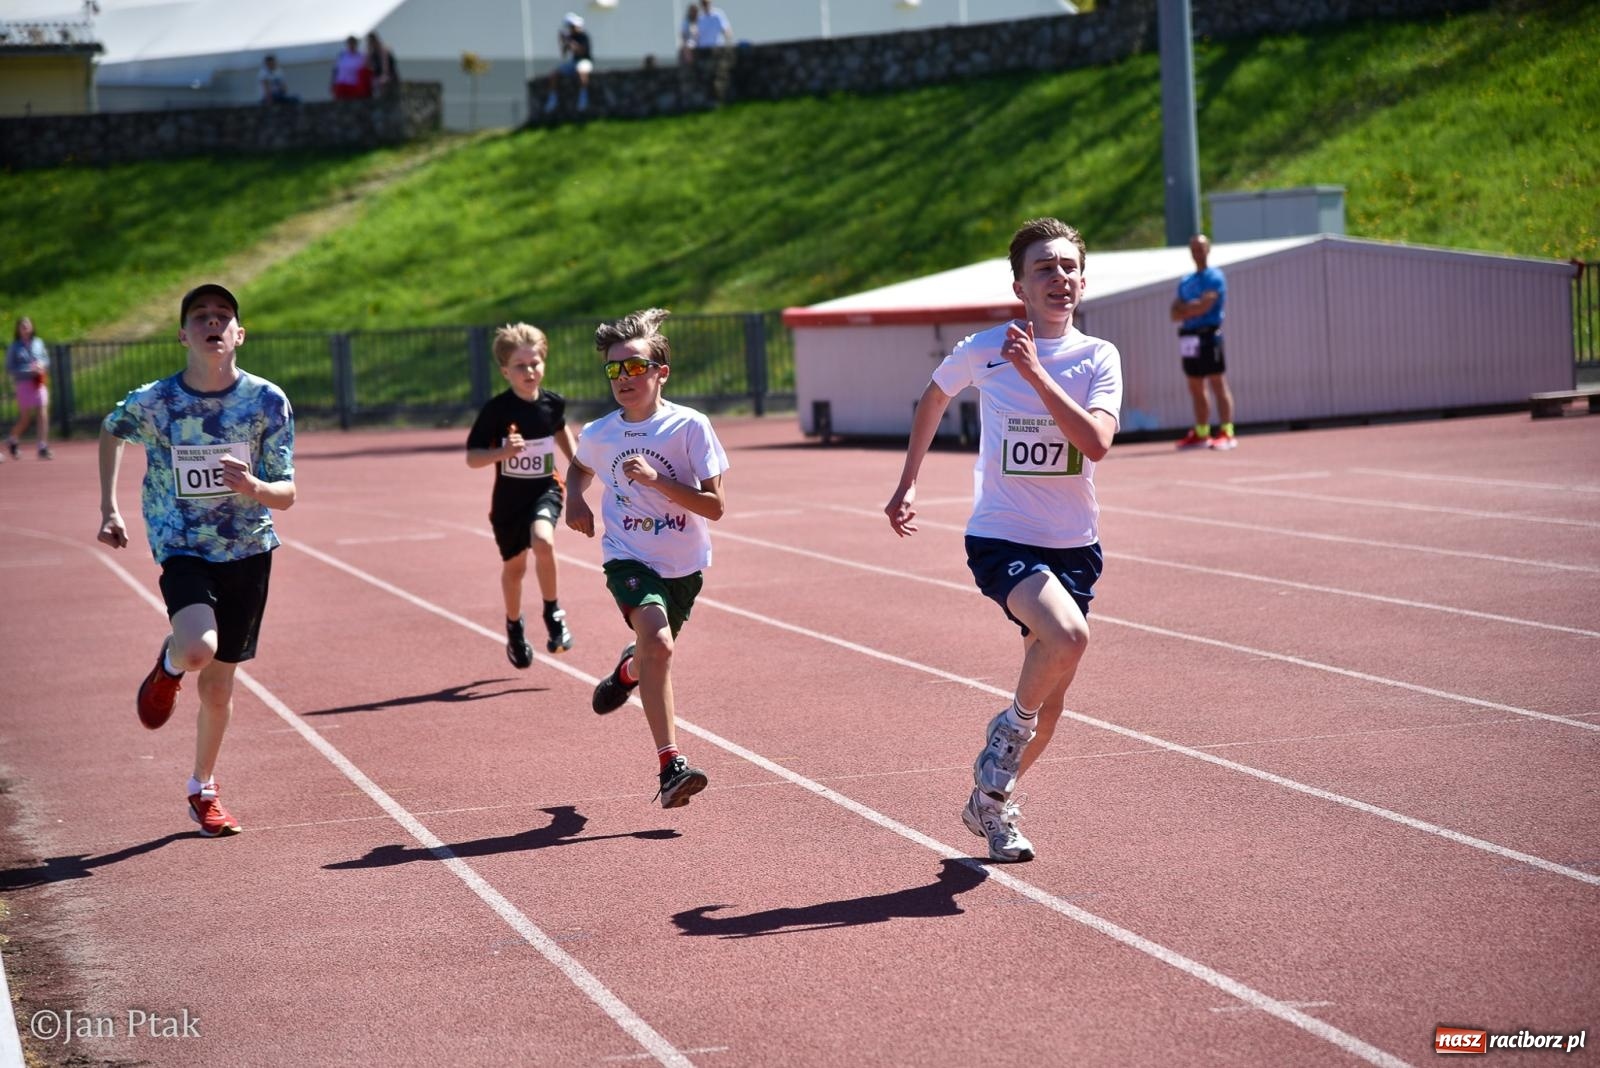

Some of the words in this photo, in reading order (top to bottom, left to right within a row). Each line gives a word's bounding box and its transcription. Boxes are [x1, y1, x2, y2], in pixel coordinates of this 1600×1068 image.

[508, 455, 542, 470] 008
[1012, 441, 1064, 466] 007
[187, 468, 225, 489] 015
[623, 513, 686, 535] trophy
